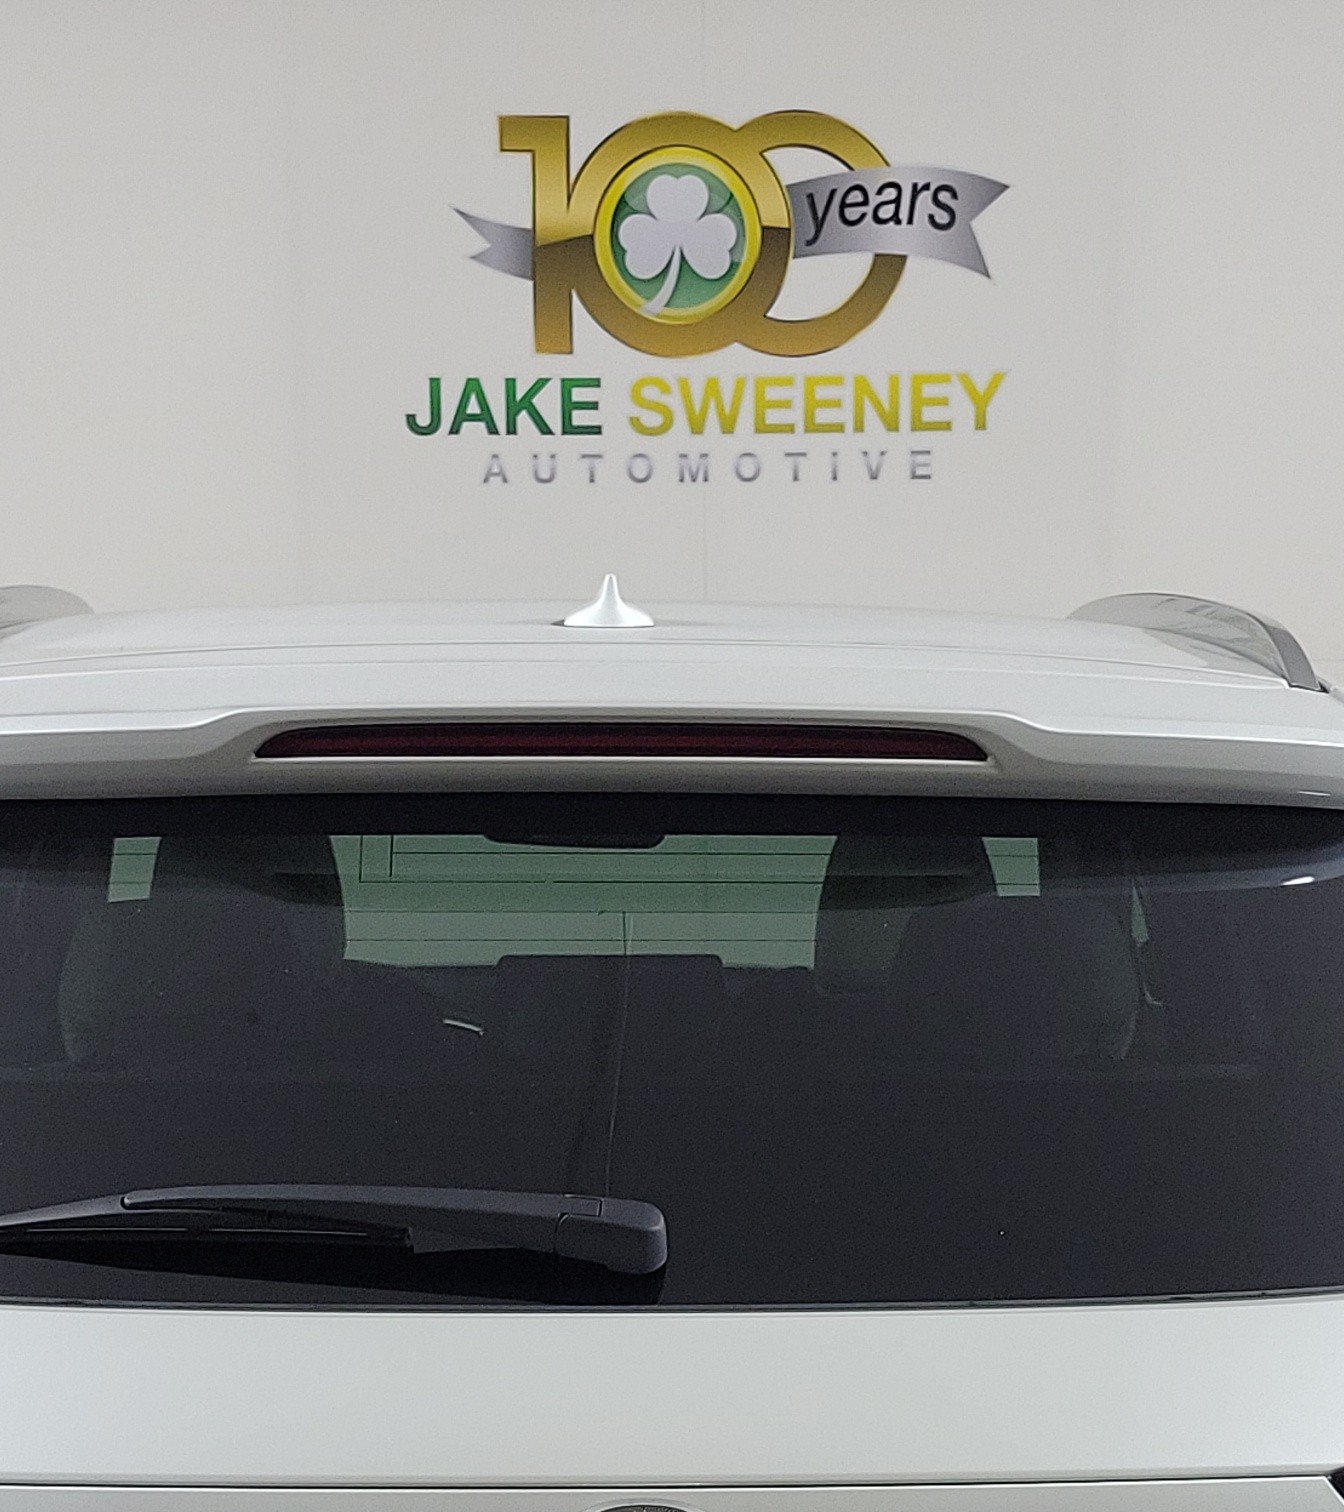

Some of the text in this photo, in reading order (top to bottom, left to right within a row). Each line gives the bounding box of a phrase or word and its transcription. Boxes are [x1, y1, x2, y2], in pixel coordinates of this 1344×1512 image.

[497, 109, 908, 358] 100
[804, 179, 959, 248] years
[405, 371, 1008, 436] JAKE SWEENEY
[482, 450, 934, 485] AUTOMOTIVE
